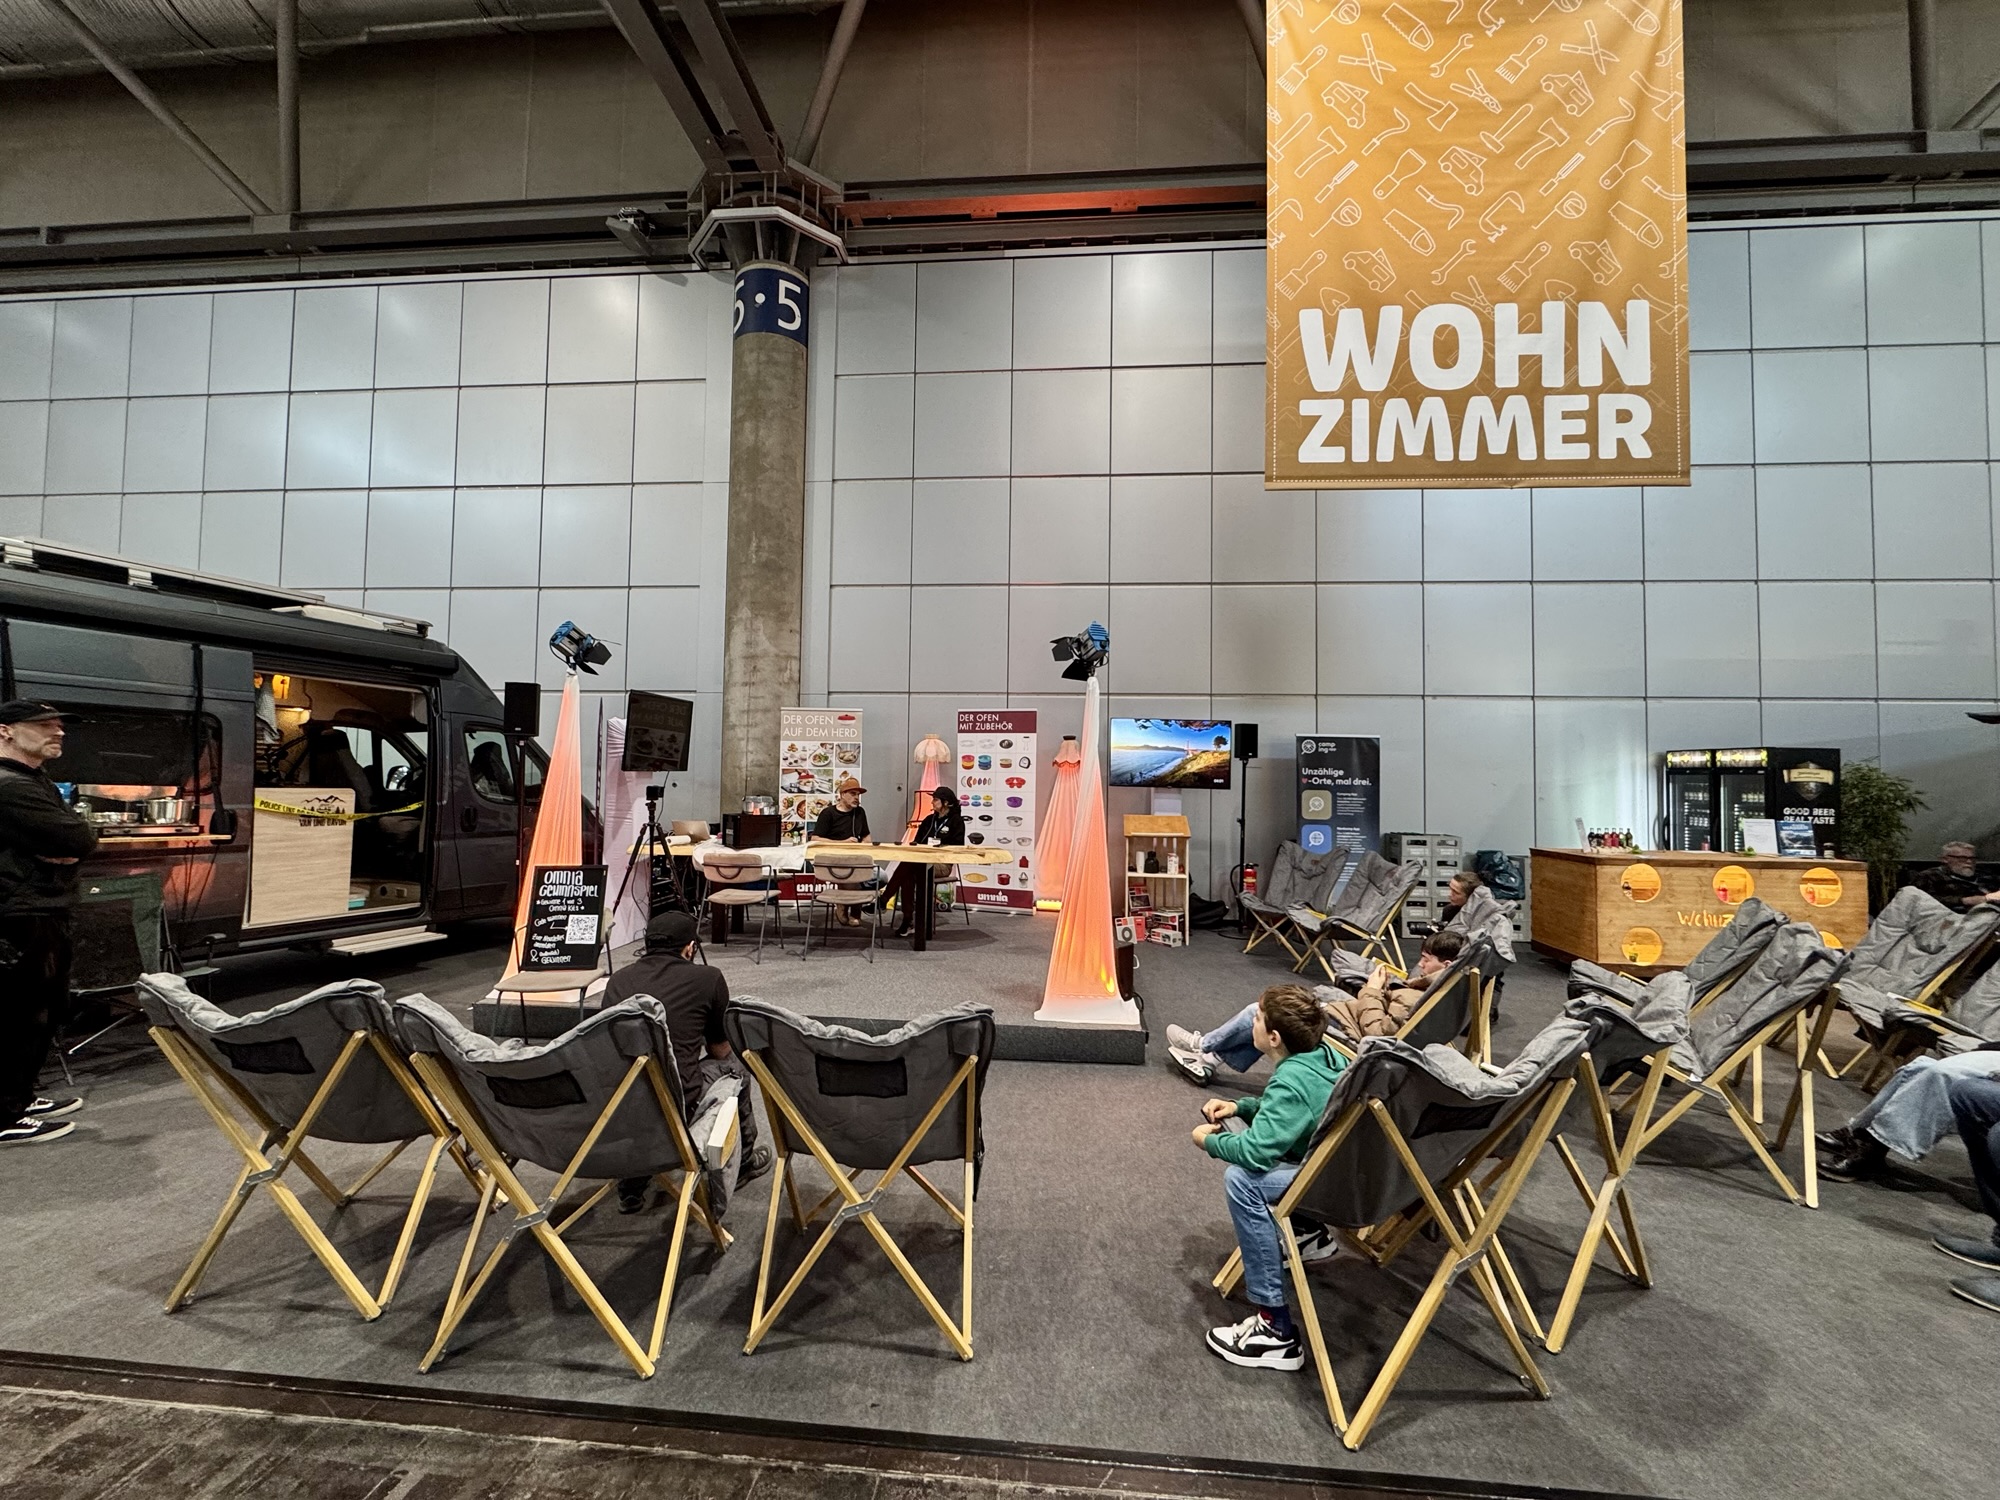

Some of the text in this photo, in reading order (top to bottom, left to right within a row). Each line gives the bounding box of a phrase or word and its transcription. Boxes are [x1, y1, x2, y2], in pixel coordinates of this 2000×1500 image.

[1298, 299, 1652, 392] WOHN
[1298, 393, 1653, 463] ZIMMER
[783, 714, 834, 725] DER OFEN
[959, 713, 999, 722] DER OFEN
[959, 721, 1013, 731] MIT ZUBEHÖR
[783, 727, 858, 738] AUF DEM HERD
[1301, 767, 1345, 778] Unzählige
[1335, 777, 1352, 785] mal
[1352, 777, 1372, 786] drei.
[259, 800, 282, 811] POLICE
[1783, 807, 1836, 816] GOOD BEER
[1807, 816, 1836, 825] TASTE
